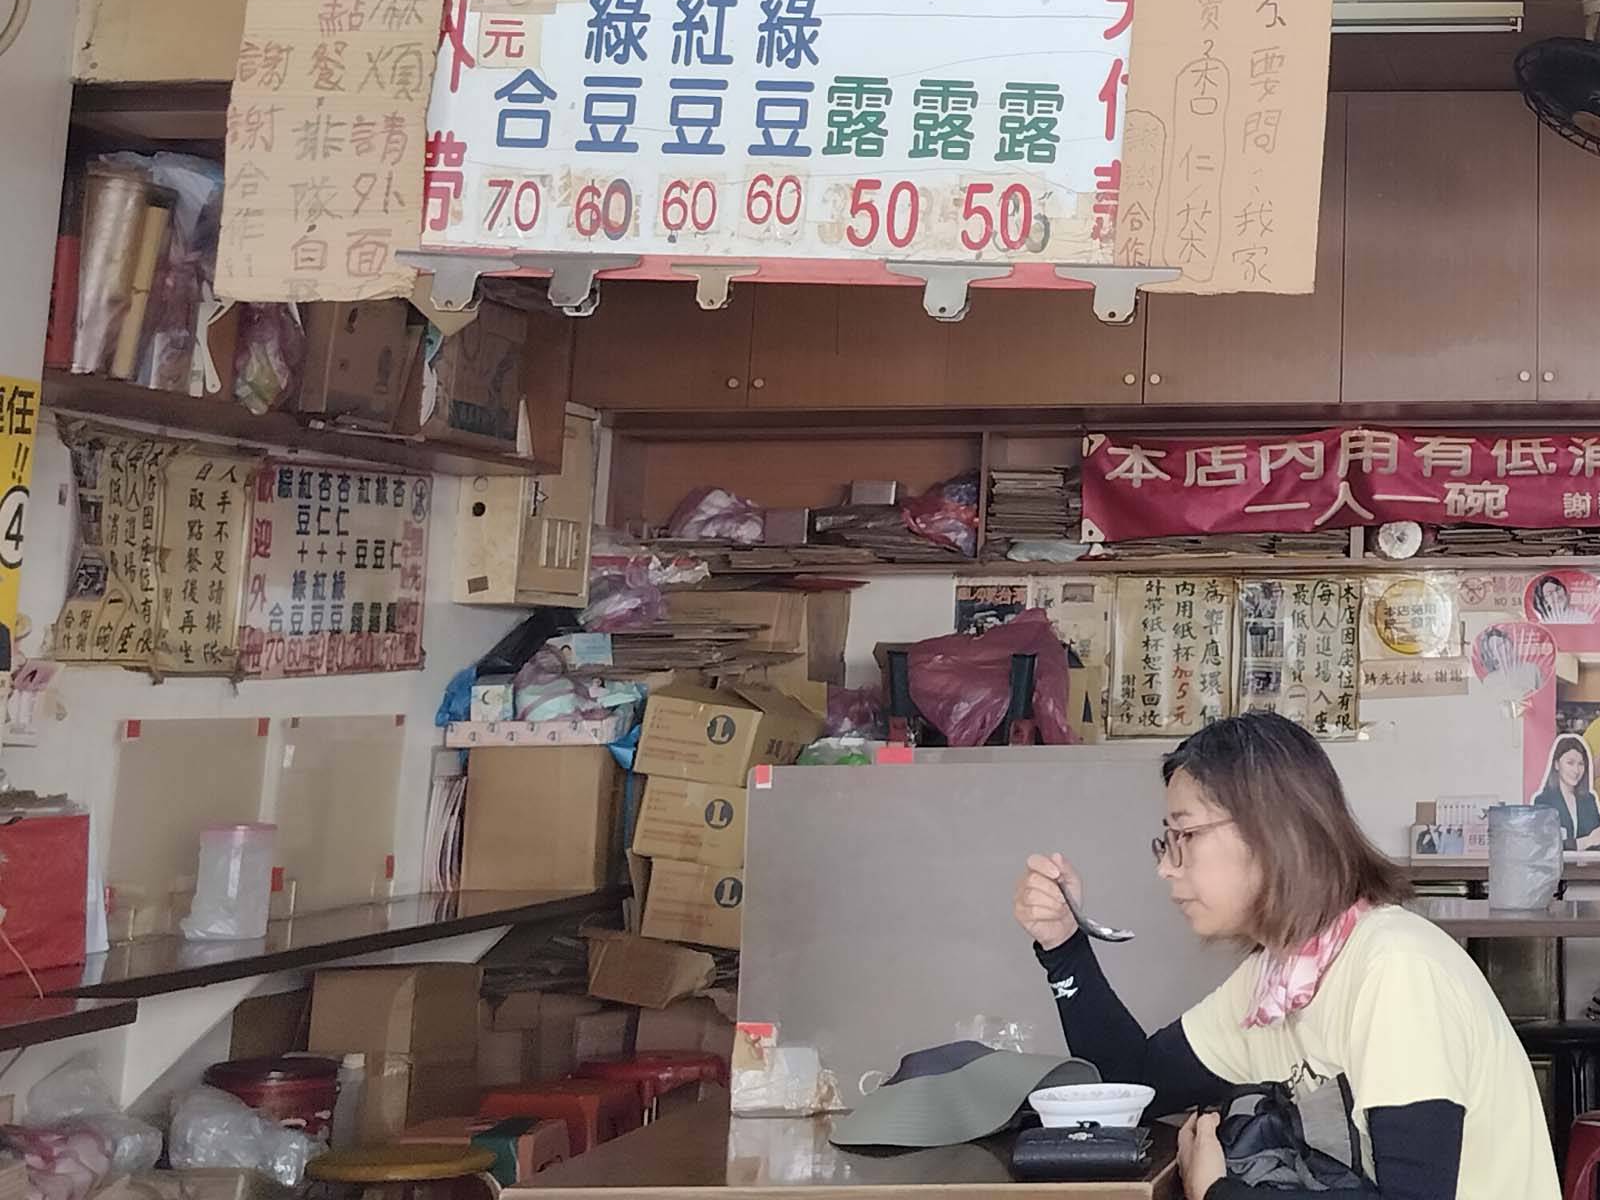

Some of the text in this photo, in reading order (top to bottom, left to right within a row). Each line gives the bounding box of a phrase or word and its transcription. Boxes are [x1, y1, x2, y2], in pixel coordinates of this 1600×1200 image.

[483, 173, 1032, 250] 70 60 60 60 50 50
[1244, 480, 1509, 526] 一人一碗
